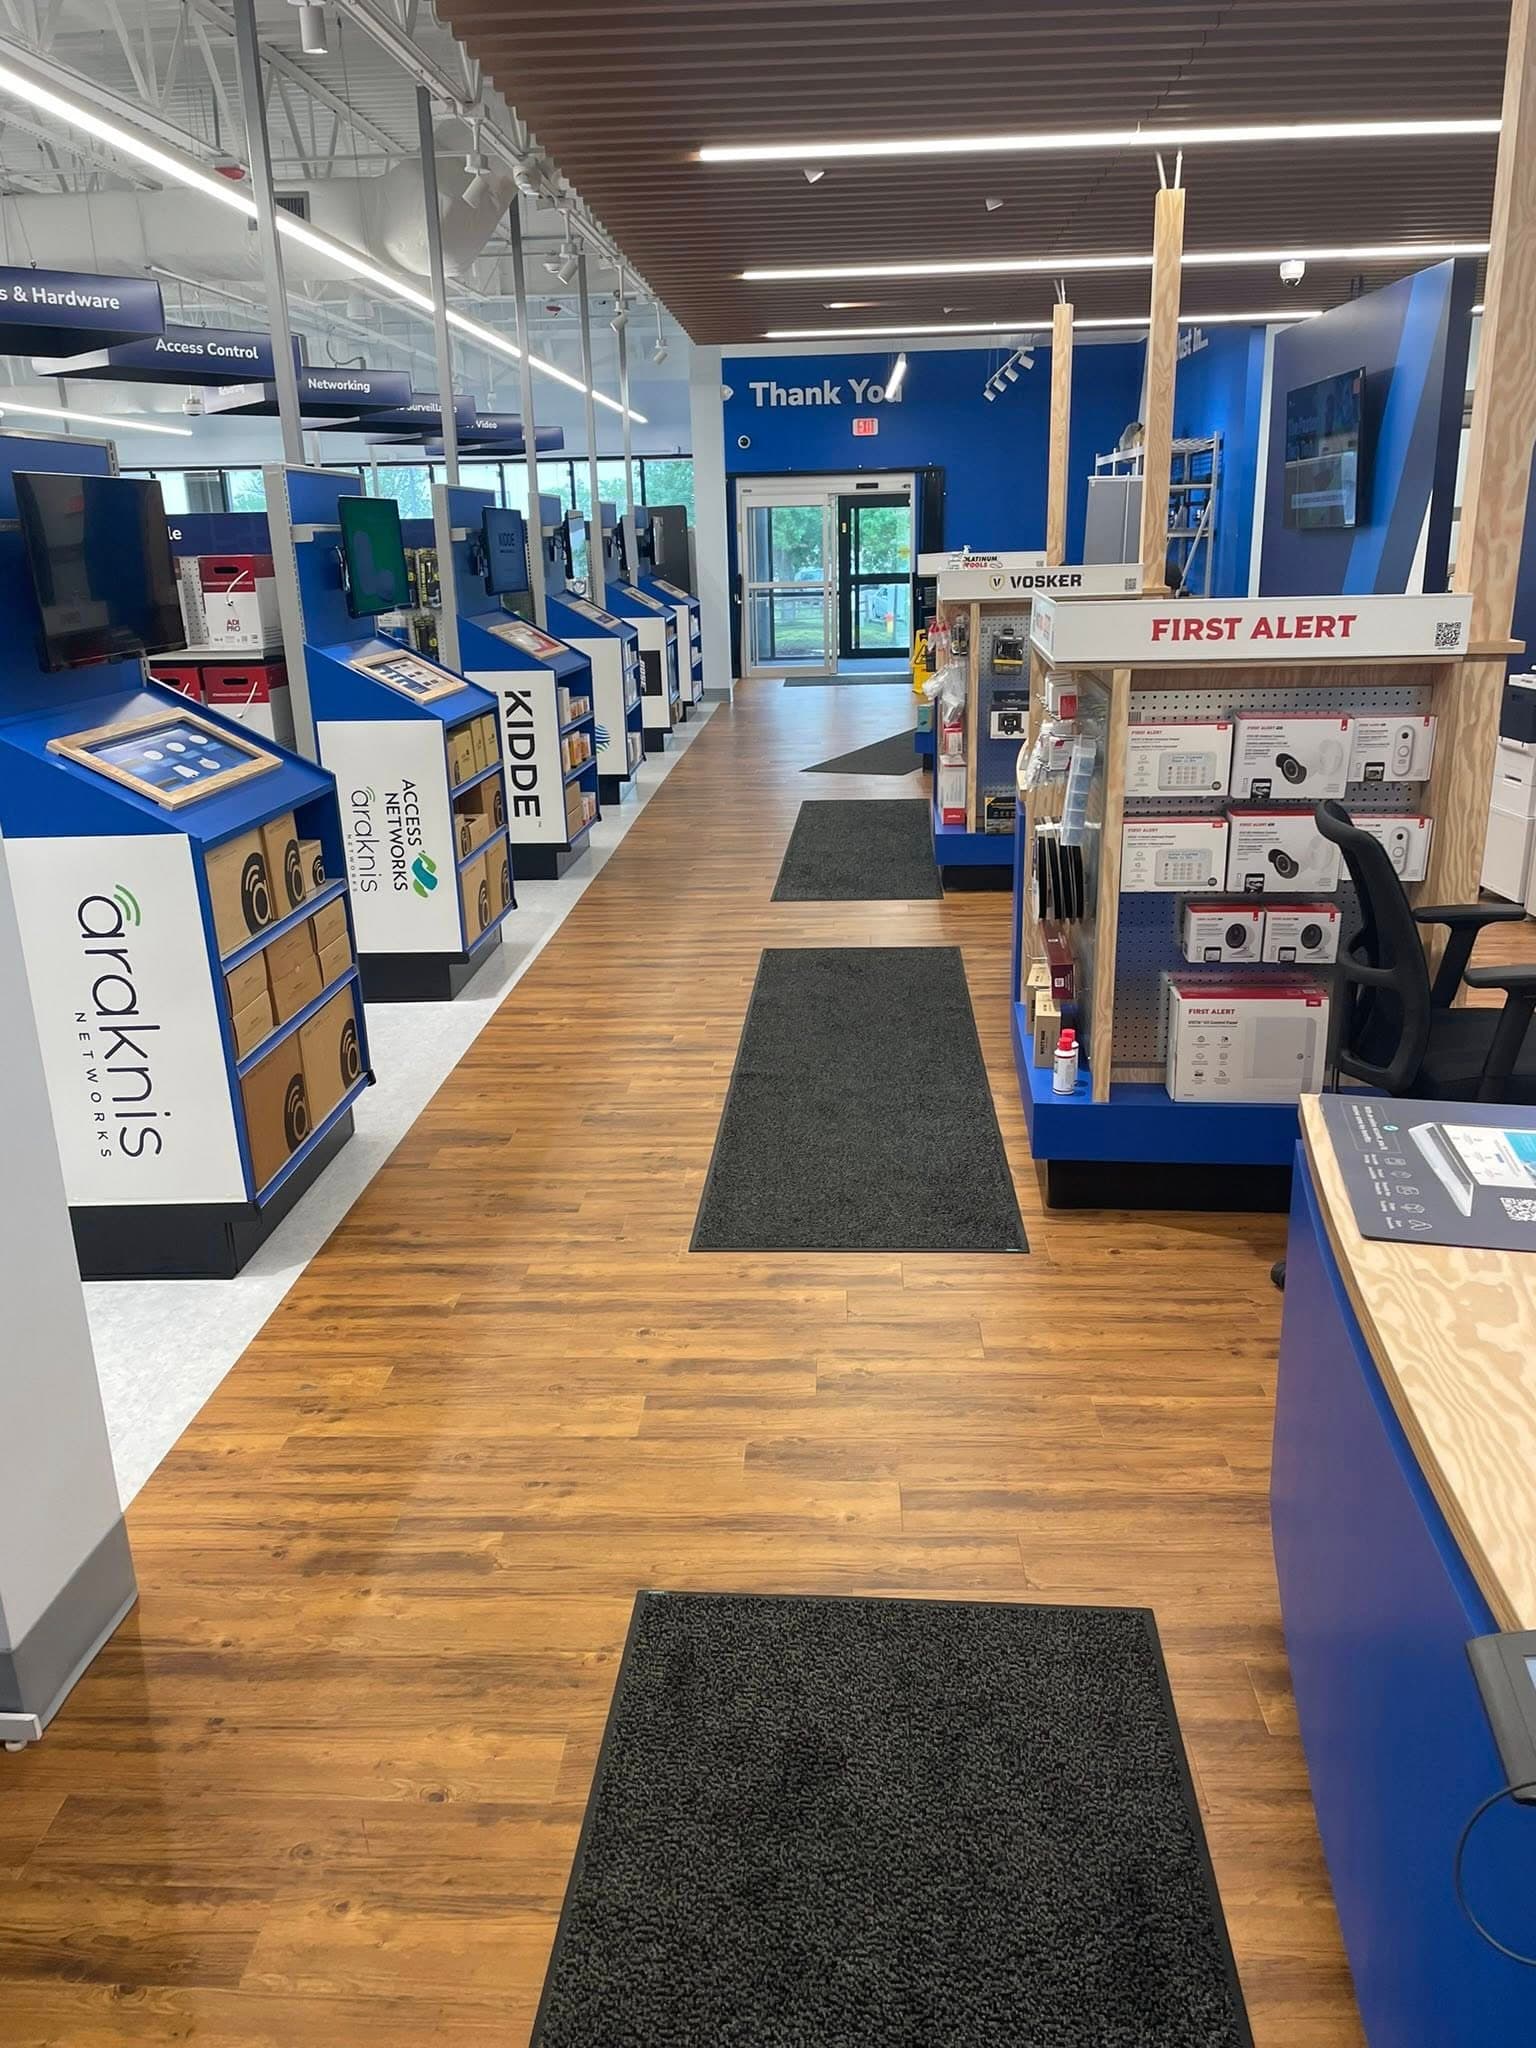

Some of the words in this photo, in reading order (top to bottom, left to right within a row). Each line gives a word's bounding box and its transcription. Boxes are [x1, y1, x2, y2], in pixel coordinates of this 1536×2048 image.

[13, 286, 28, 302] &
[32, 287, 120, 309] Hardware
[155, 338, 204, 354] Access
[207, 342, 259, 360] Control
[308, 378, 371, 393] Networking
[749, 380, 841, 407] Thank
[475, 420, 498, 429] Video
[1010, 574, 1082, 589] VOSKER
[1151, 617, 1243, 641] FIRST
[1250, 615, 1358, 640] ALERT
[504, 690, 541, 818] KIDDE
[401, 779, 422, 847] ACCESS
[351, 790, 382, 892] araknis
[384, 792, 409, 892] NETWORKS
[77, 895, 172, 1158] araknis
[75, 1012, 112, 1157] NETWORKS
